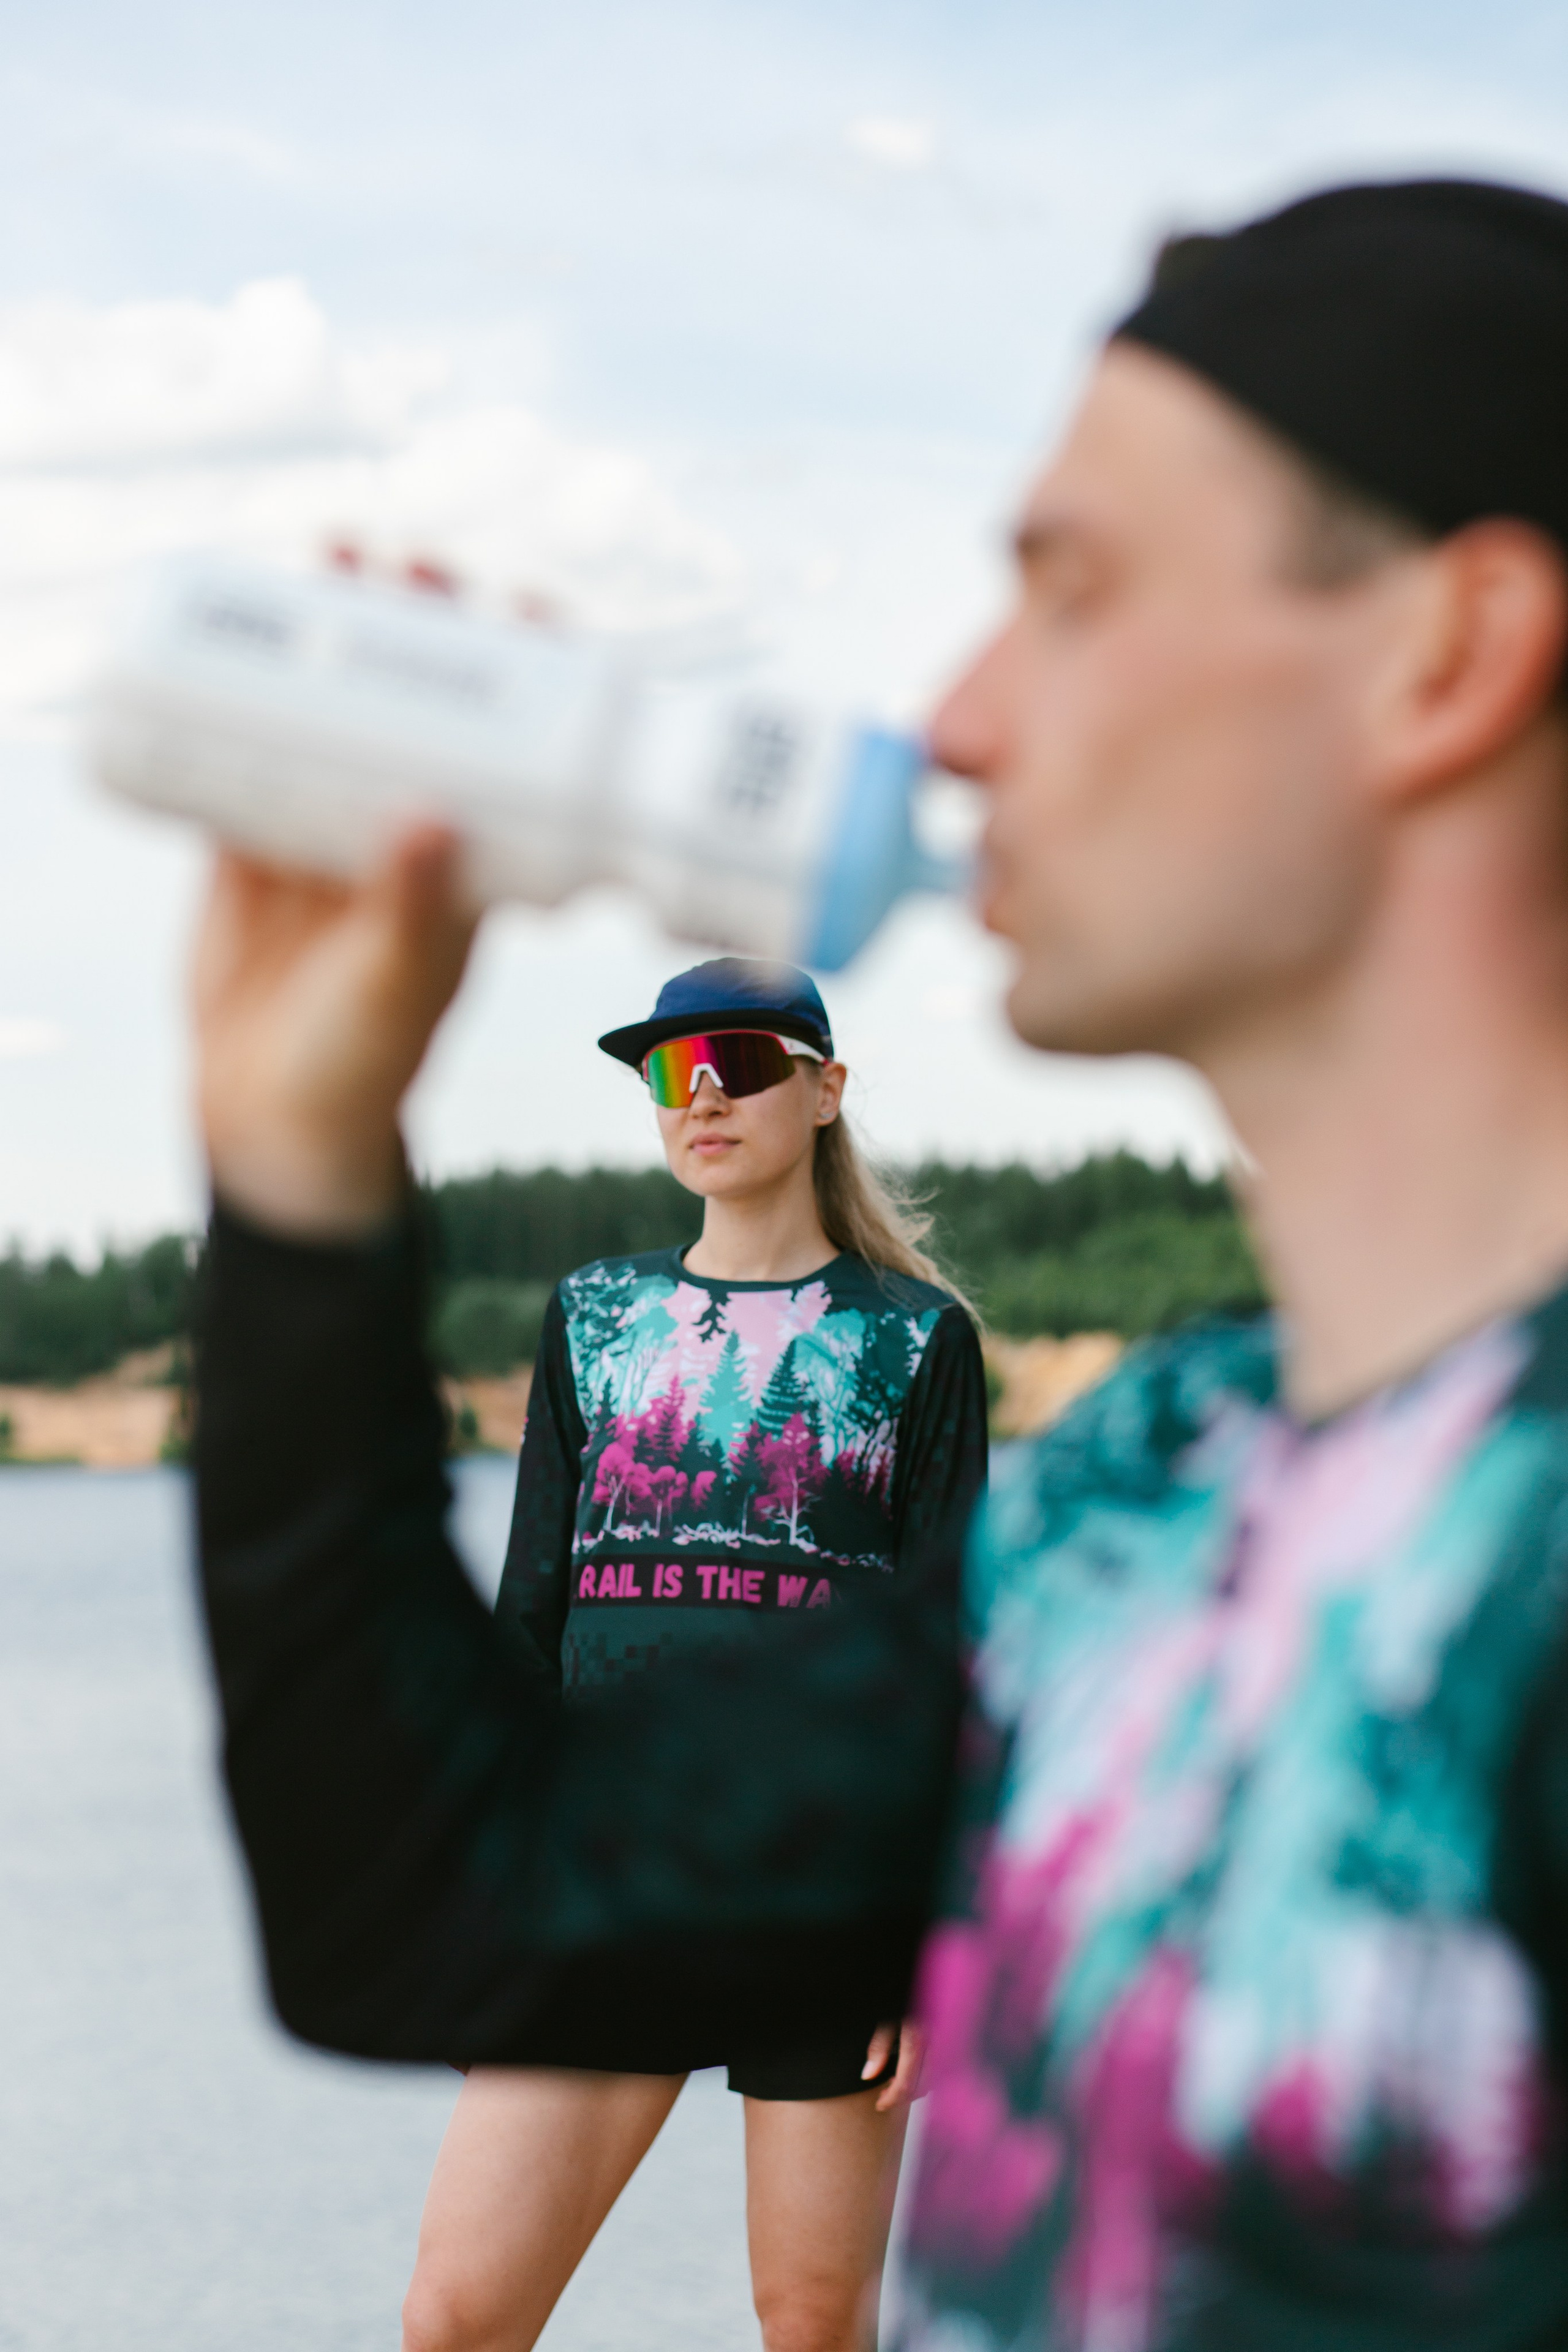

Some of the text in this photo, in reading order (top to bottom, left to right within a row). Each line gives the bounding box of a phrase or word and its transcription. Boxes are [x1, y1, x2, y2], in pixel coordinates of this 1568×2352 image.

[573, 1563, 843, 1610] RAIL IS THE WA
